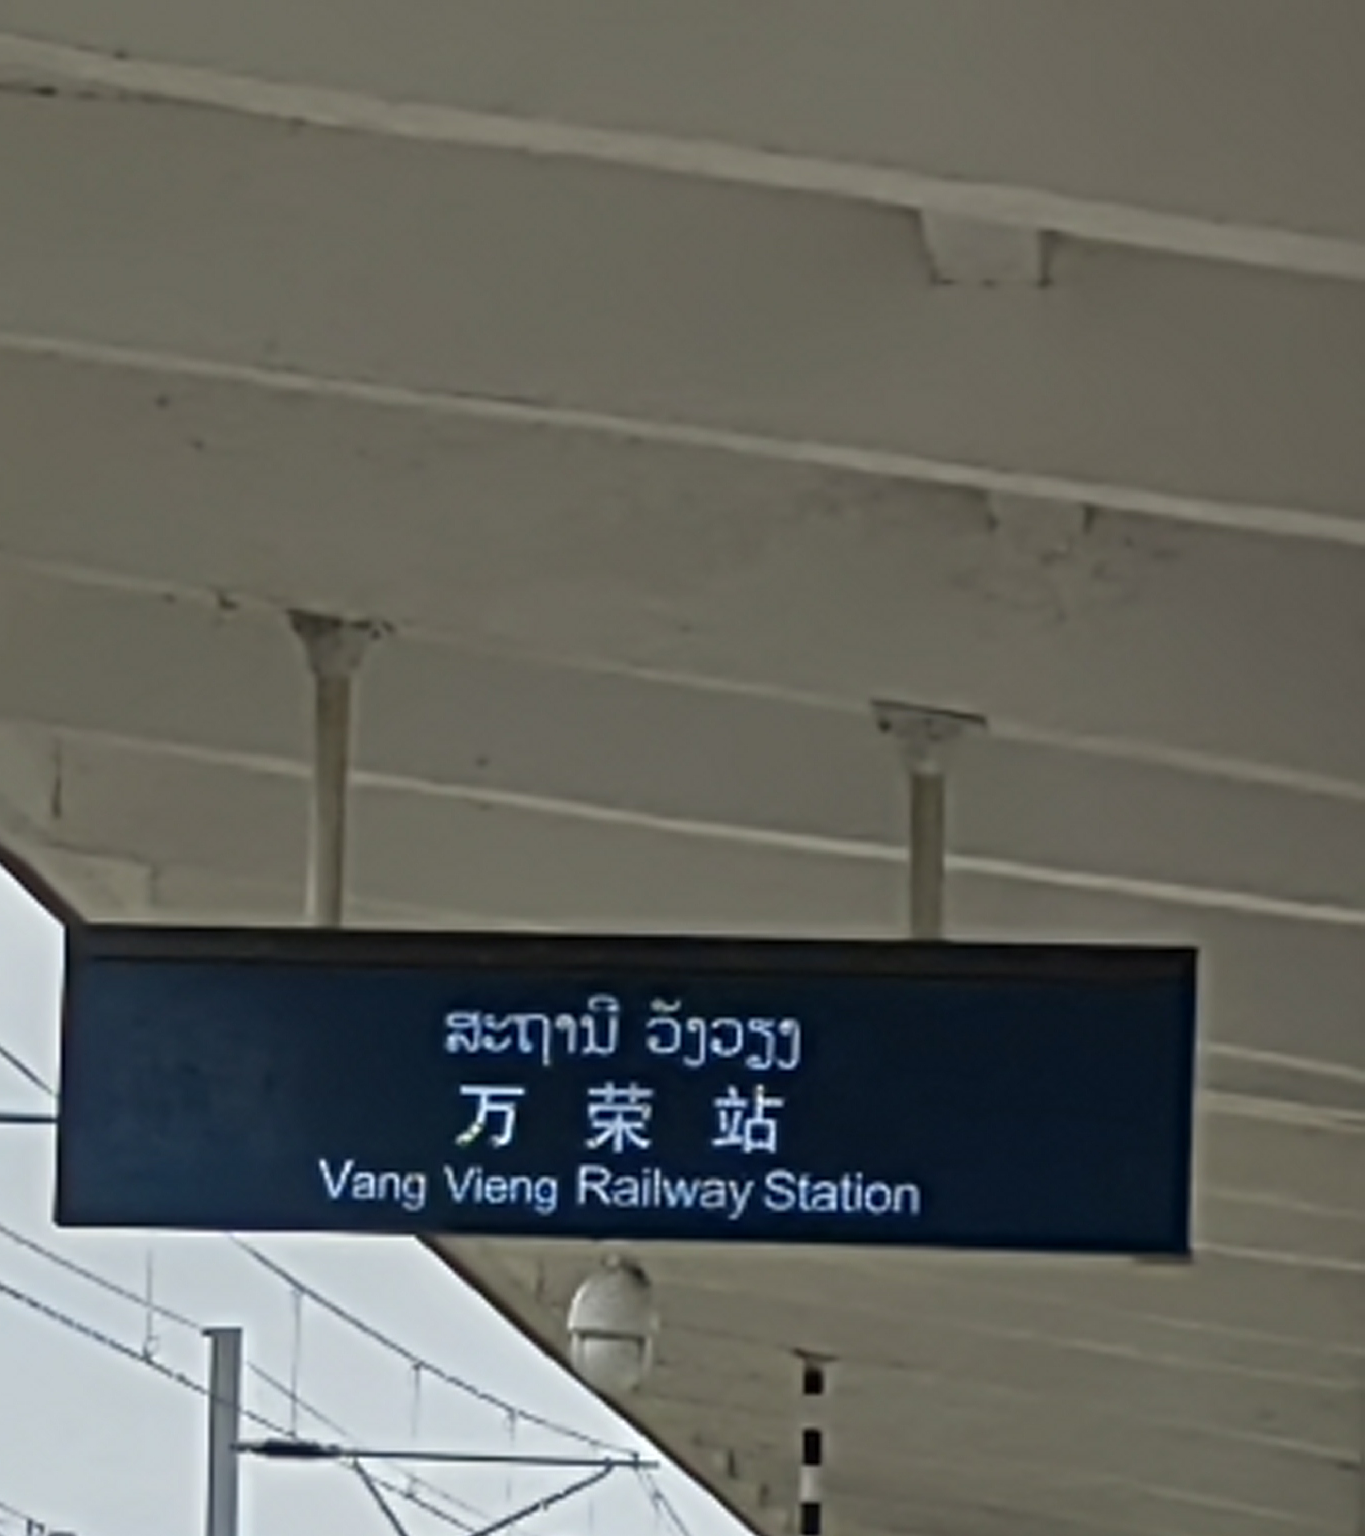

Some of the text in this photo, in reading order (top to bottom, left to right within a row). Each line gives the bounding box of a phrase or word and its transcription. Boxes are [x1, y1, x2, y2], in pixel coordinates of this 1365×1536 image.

[444, 993, 802, 1070] ສະຖານີ ວັງວຽງ
[455, 1082, 785, 1154] 万荣站
[319, 1159, 921, 1220] Vang Vieng Railway Station
